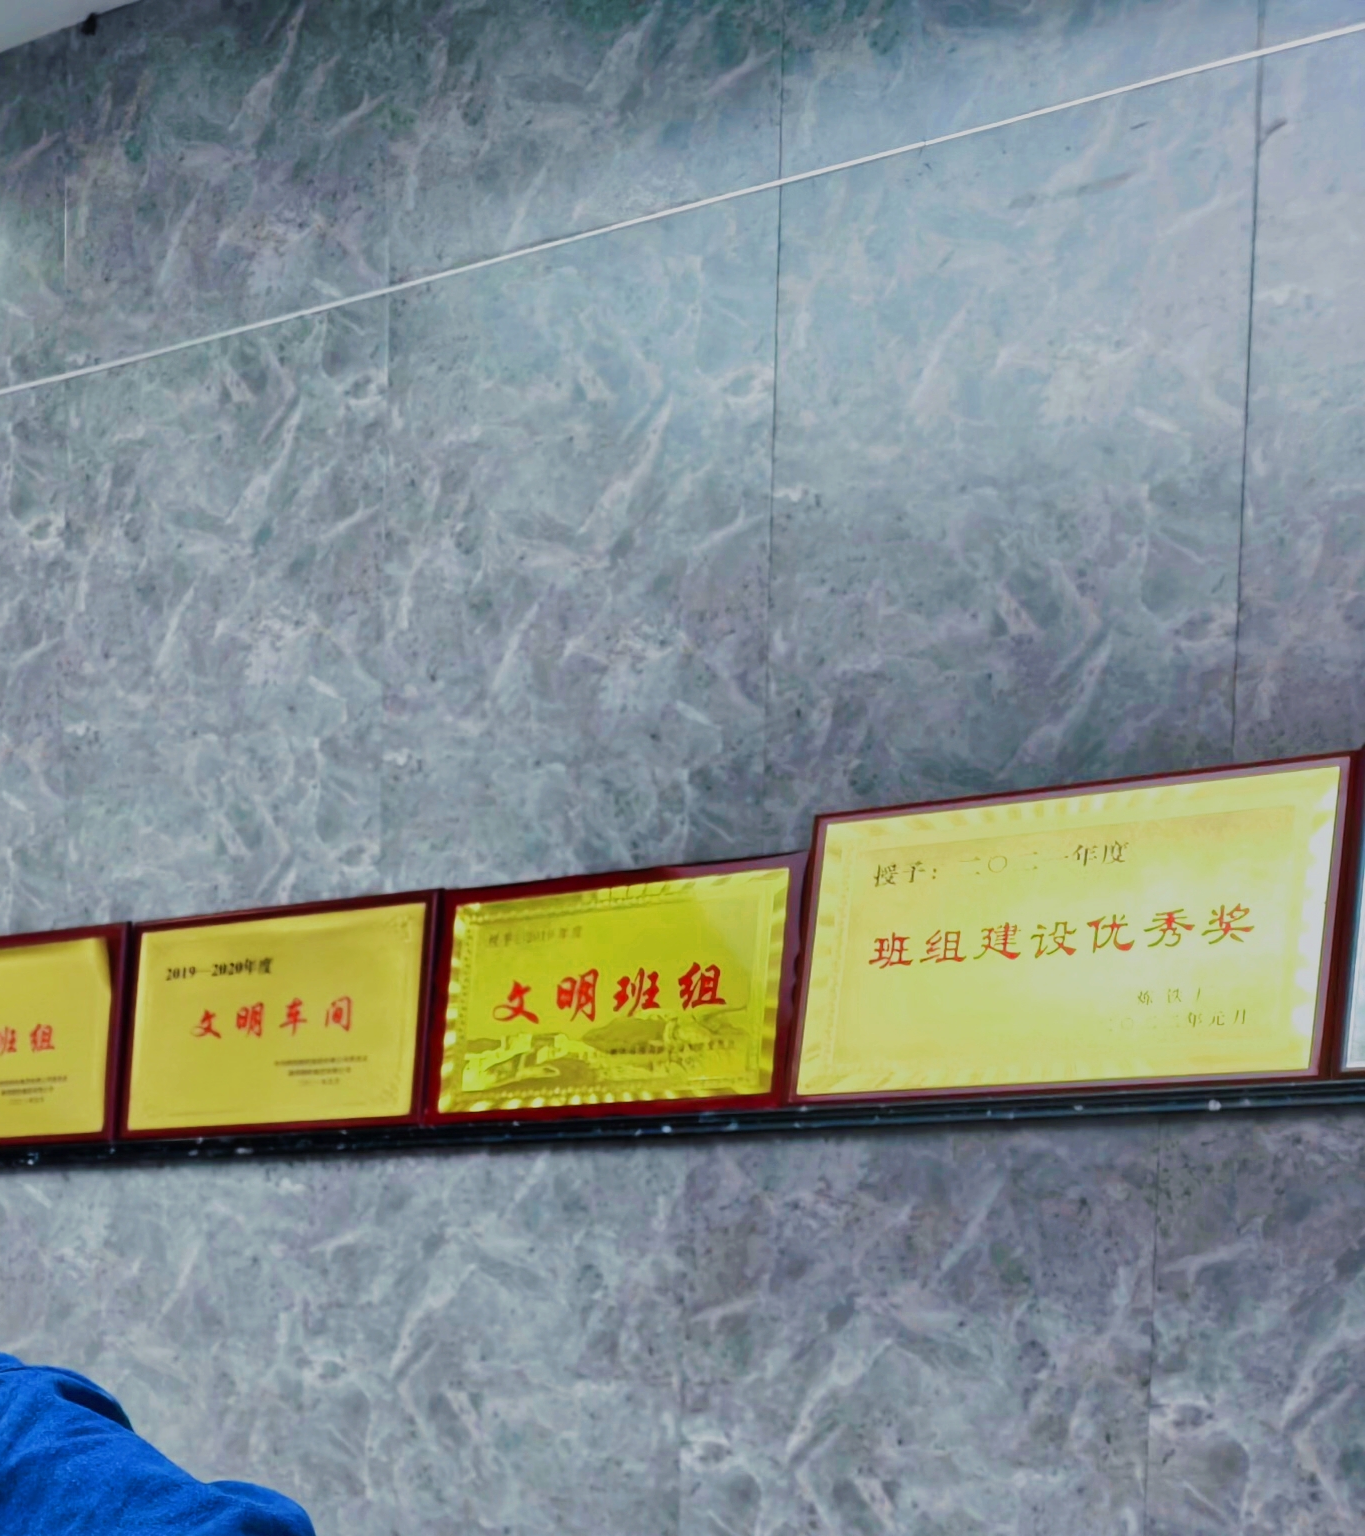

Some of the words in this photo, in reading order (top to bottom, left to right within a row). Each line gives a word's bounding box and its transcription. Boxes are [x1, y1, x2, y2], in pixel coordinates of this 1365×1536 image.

[868, 903, 1255, 969] 班组建设优秀奖
[190, 996, 352, 1039] 文明车间
[492, 962, 726, 1024] 文明班组
